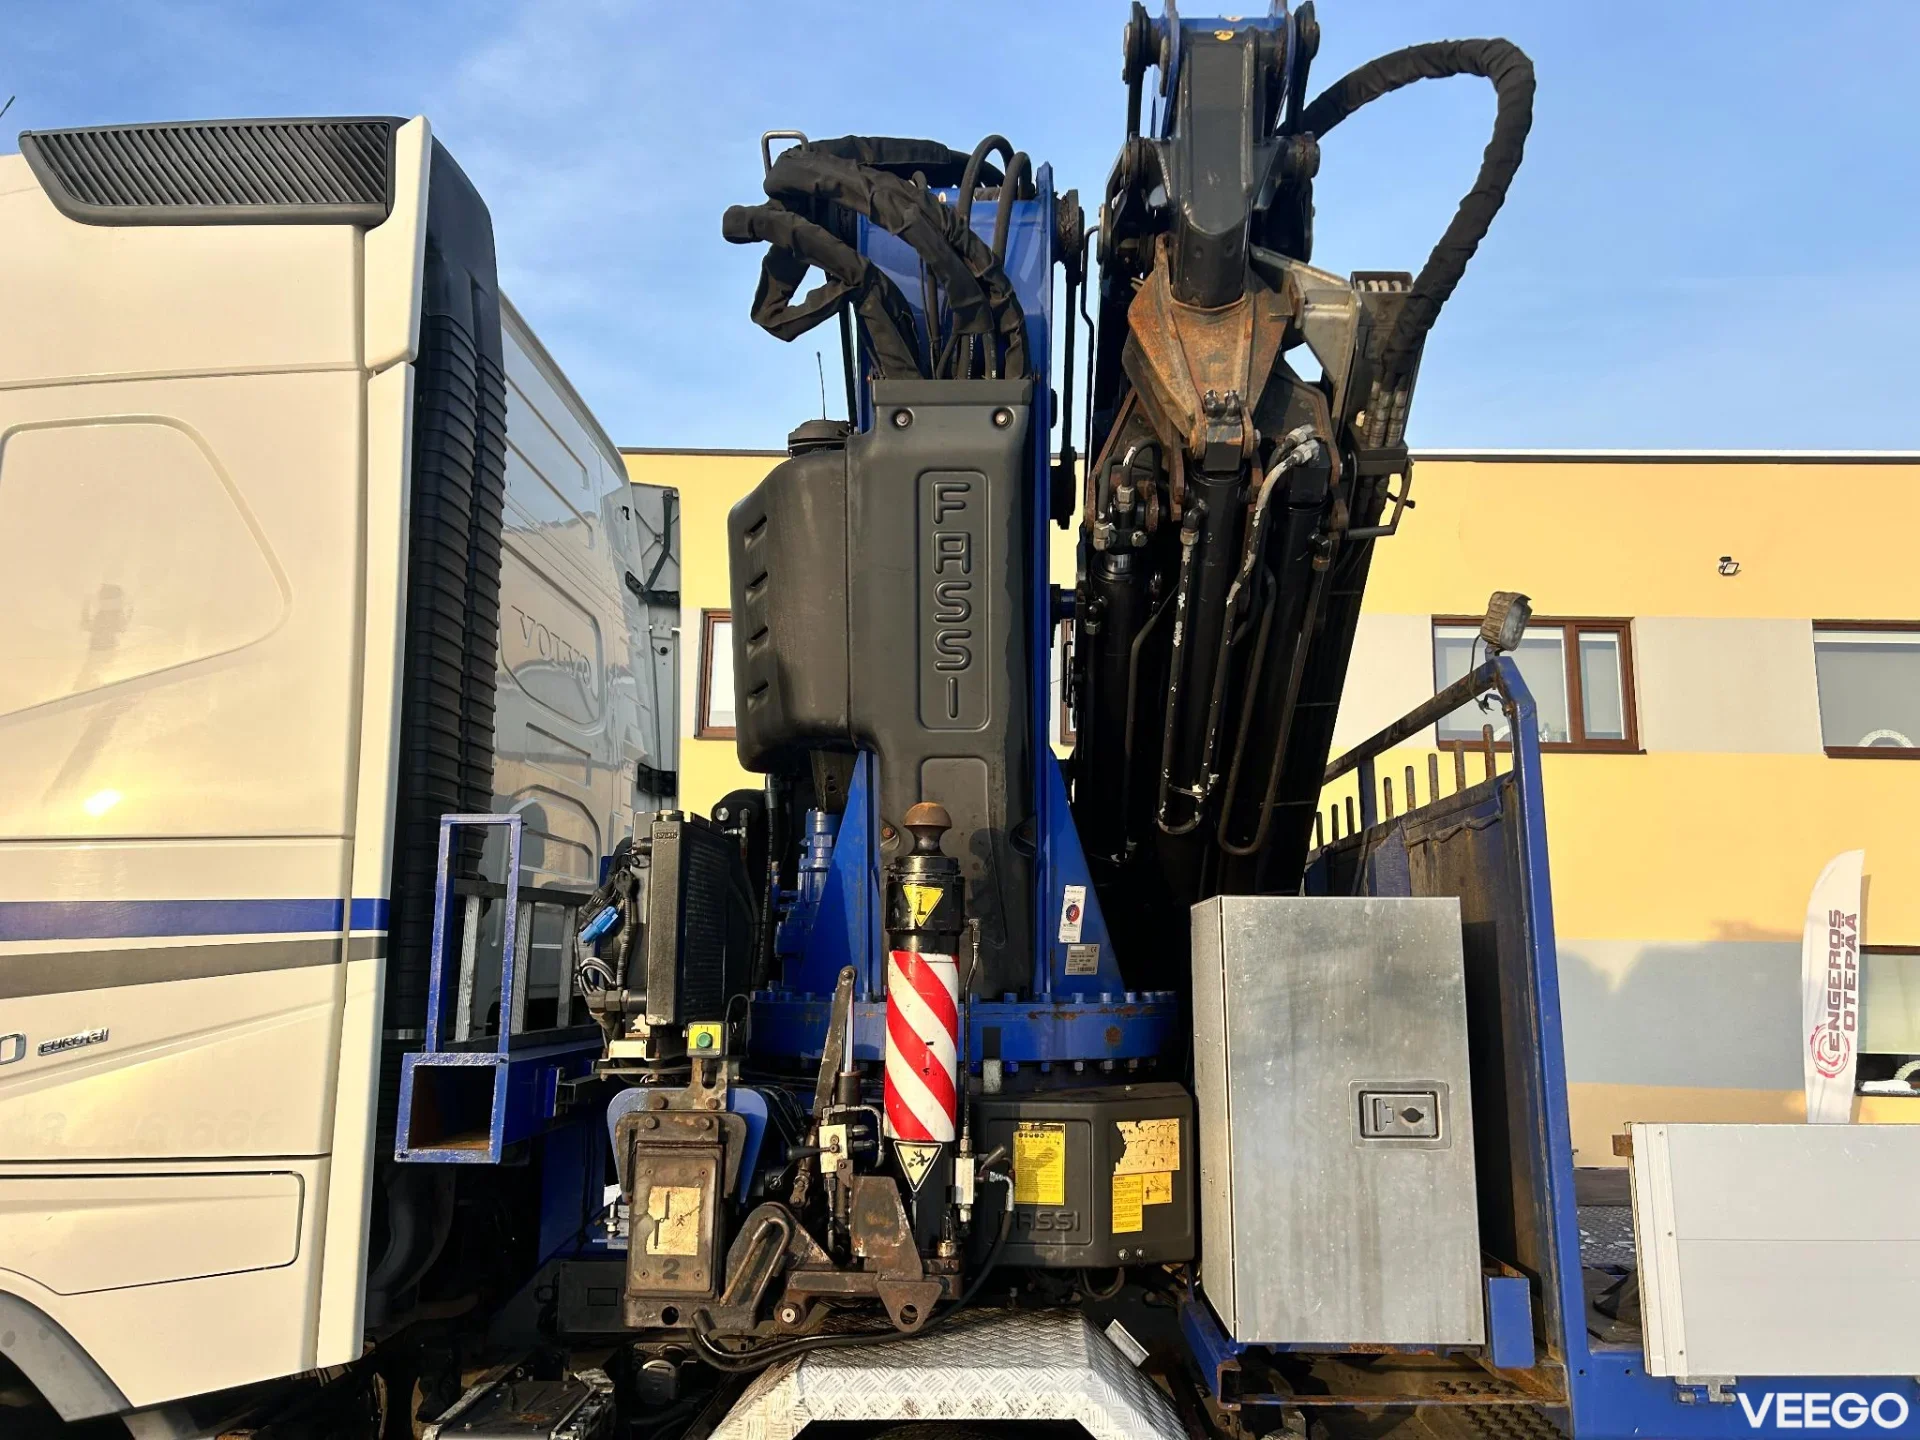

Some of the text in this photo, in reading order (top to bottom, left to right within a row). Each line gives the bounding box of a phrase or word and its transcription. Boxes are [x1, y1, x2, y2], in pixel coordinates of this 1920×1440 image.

[510, 604, 593, 690] VOLVO
[933, 481, 972, 720] FASSI
[1827, 908, 1843, 1052] ENGEROS
[1842, 912, 1858, 1032] OTEPÄÄ
[662, 1258, 680, 1281] 2
